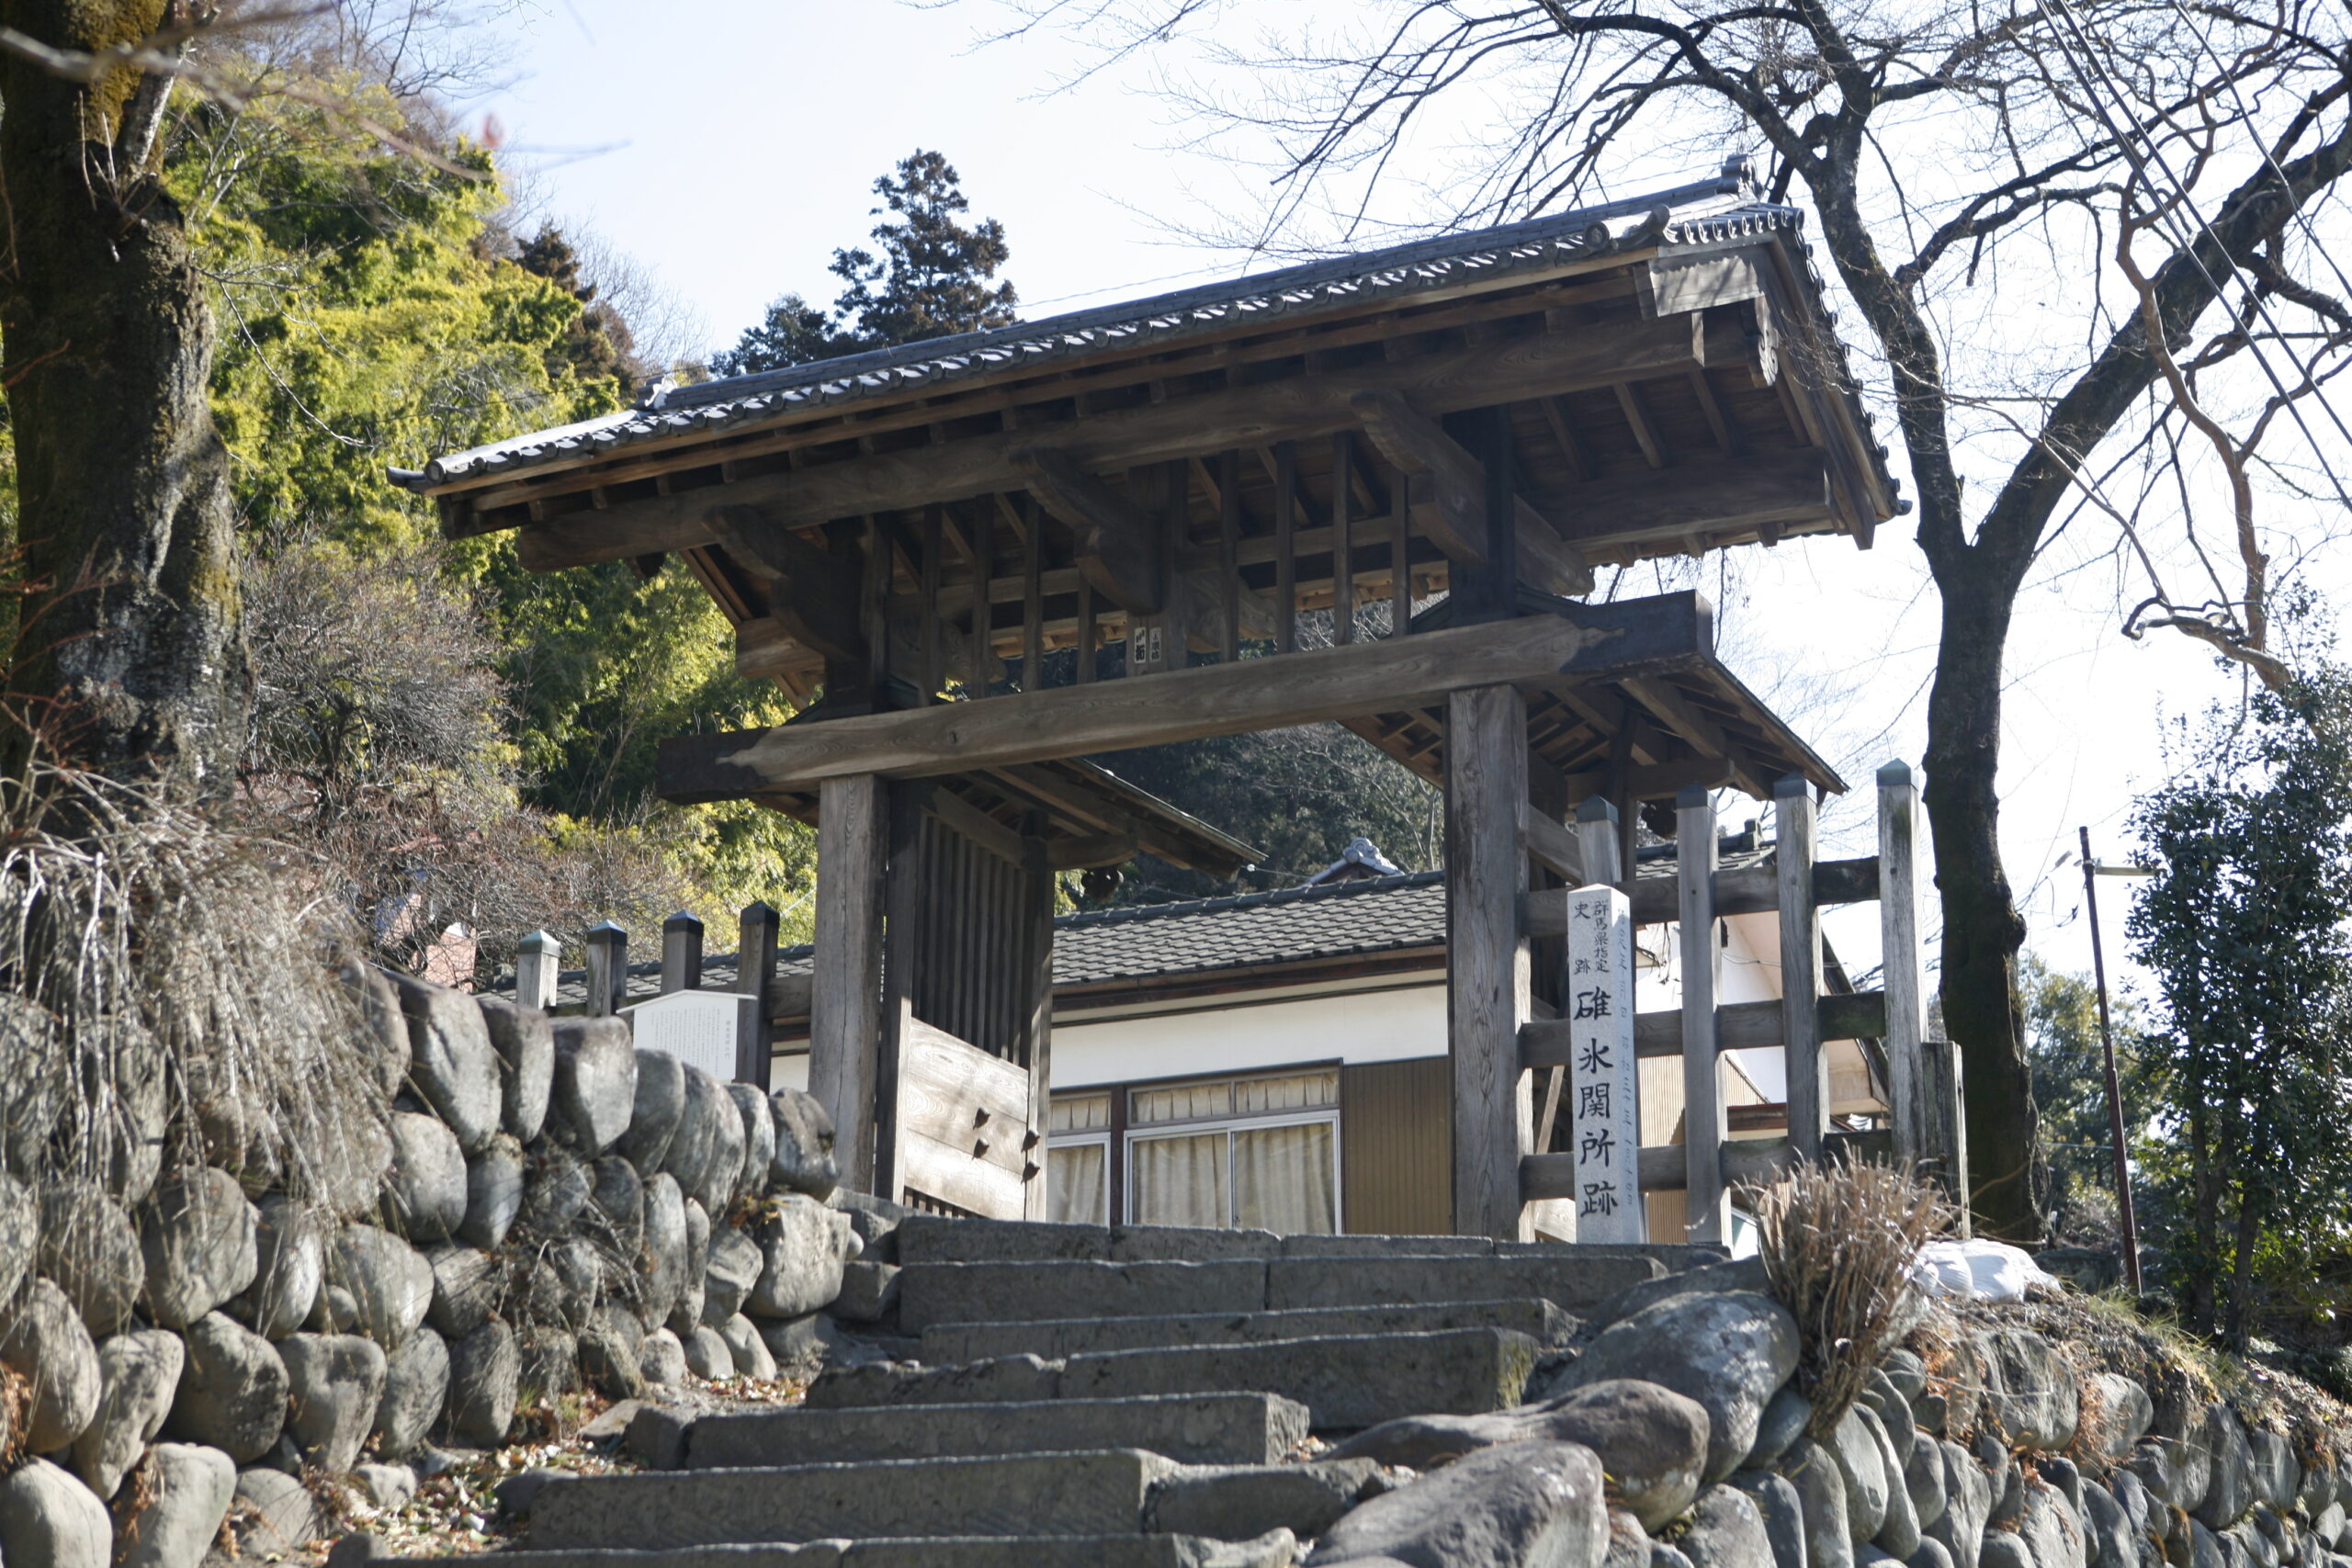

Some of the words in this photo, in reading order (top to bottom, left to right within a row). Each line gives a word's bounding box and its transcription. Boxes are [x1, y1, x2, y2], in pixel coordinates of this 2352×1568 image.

[1574, 986, 1618, 1218] 碓氷関所跡
